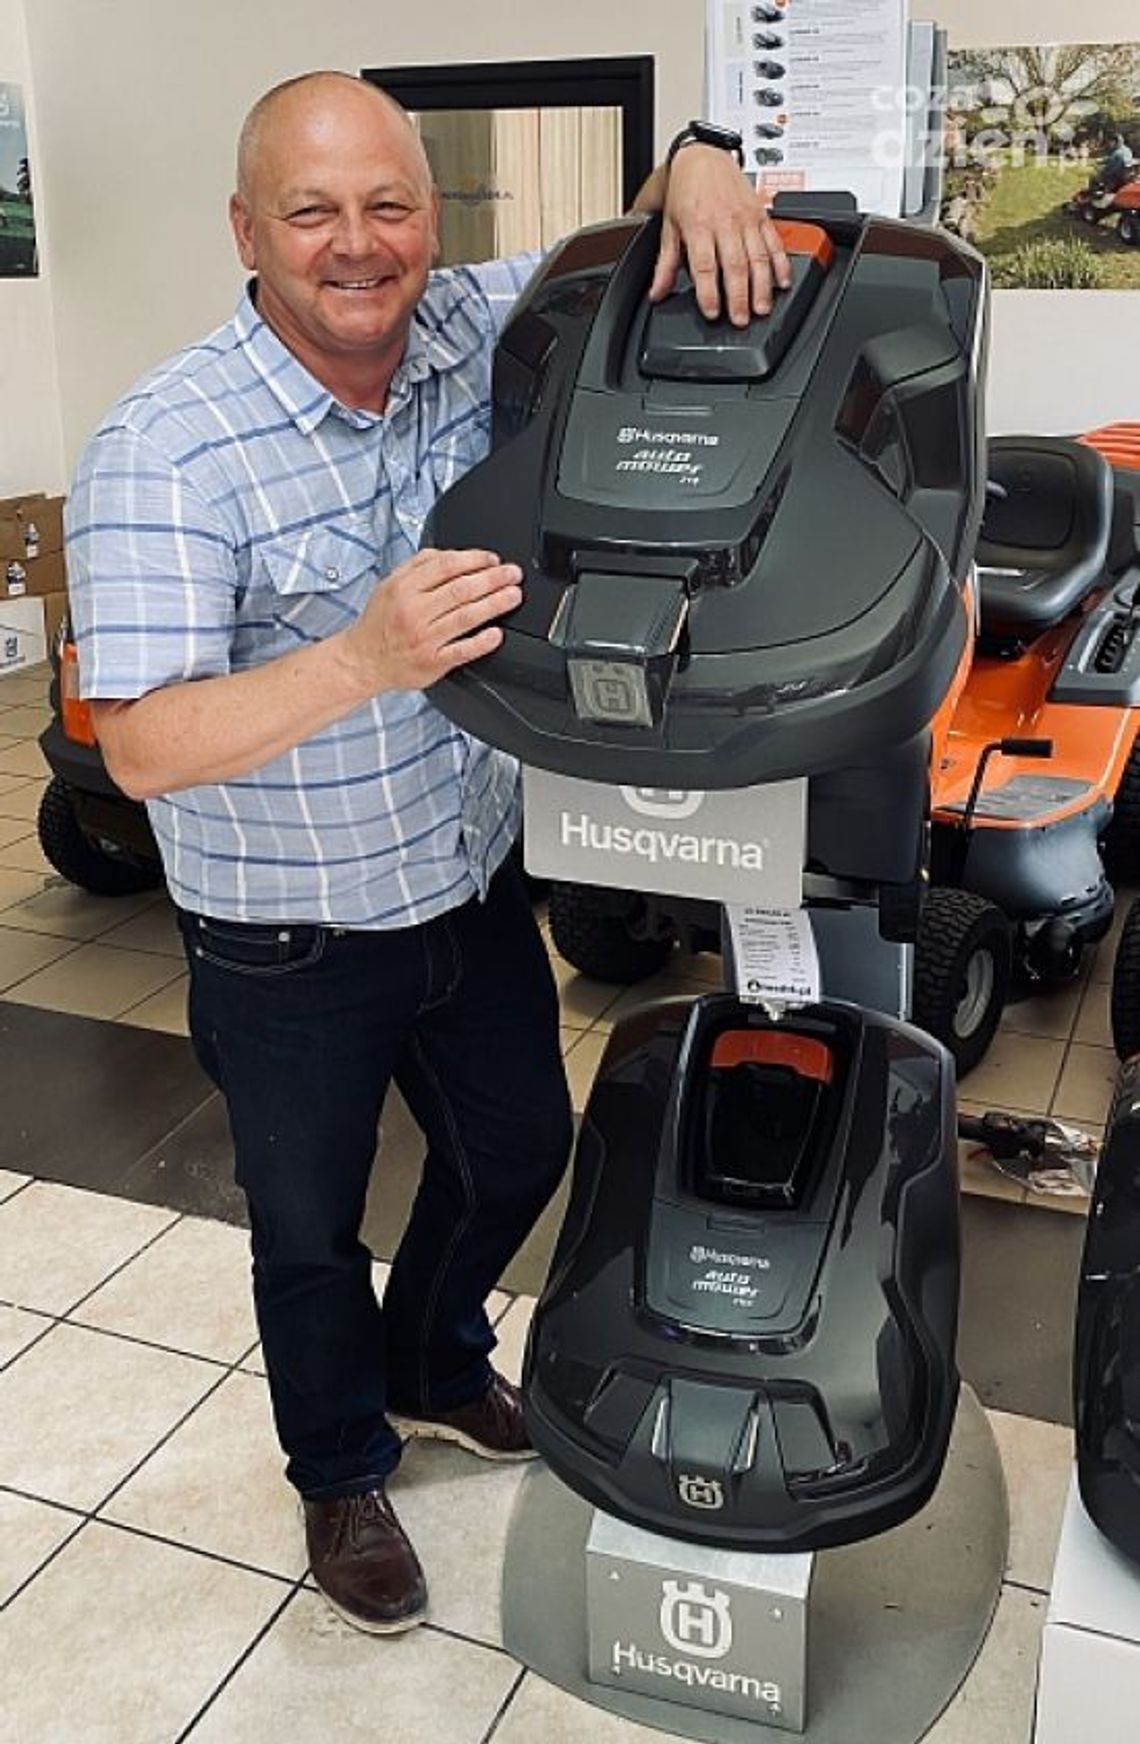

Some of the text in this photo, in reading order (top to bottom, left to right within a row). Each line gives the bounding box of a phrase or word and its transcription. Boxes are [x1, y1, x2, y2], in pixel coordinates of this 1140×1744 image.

[616, 461, 703, 475] mower
[561, 811, 763, 871] Husqvarna
[612, 1640, 782, 1703] Husqvarna
